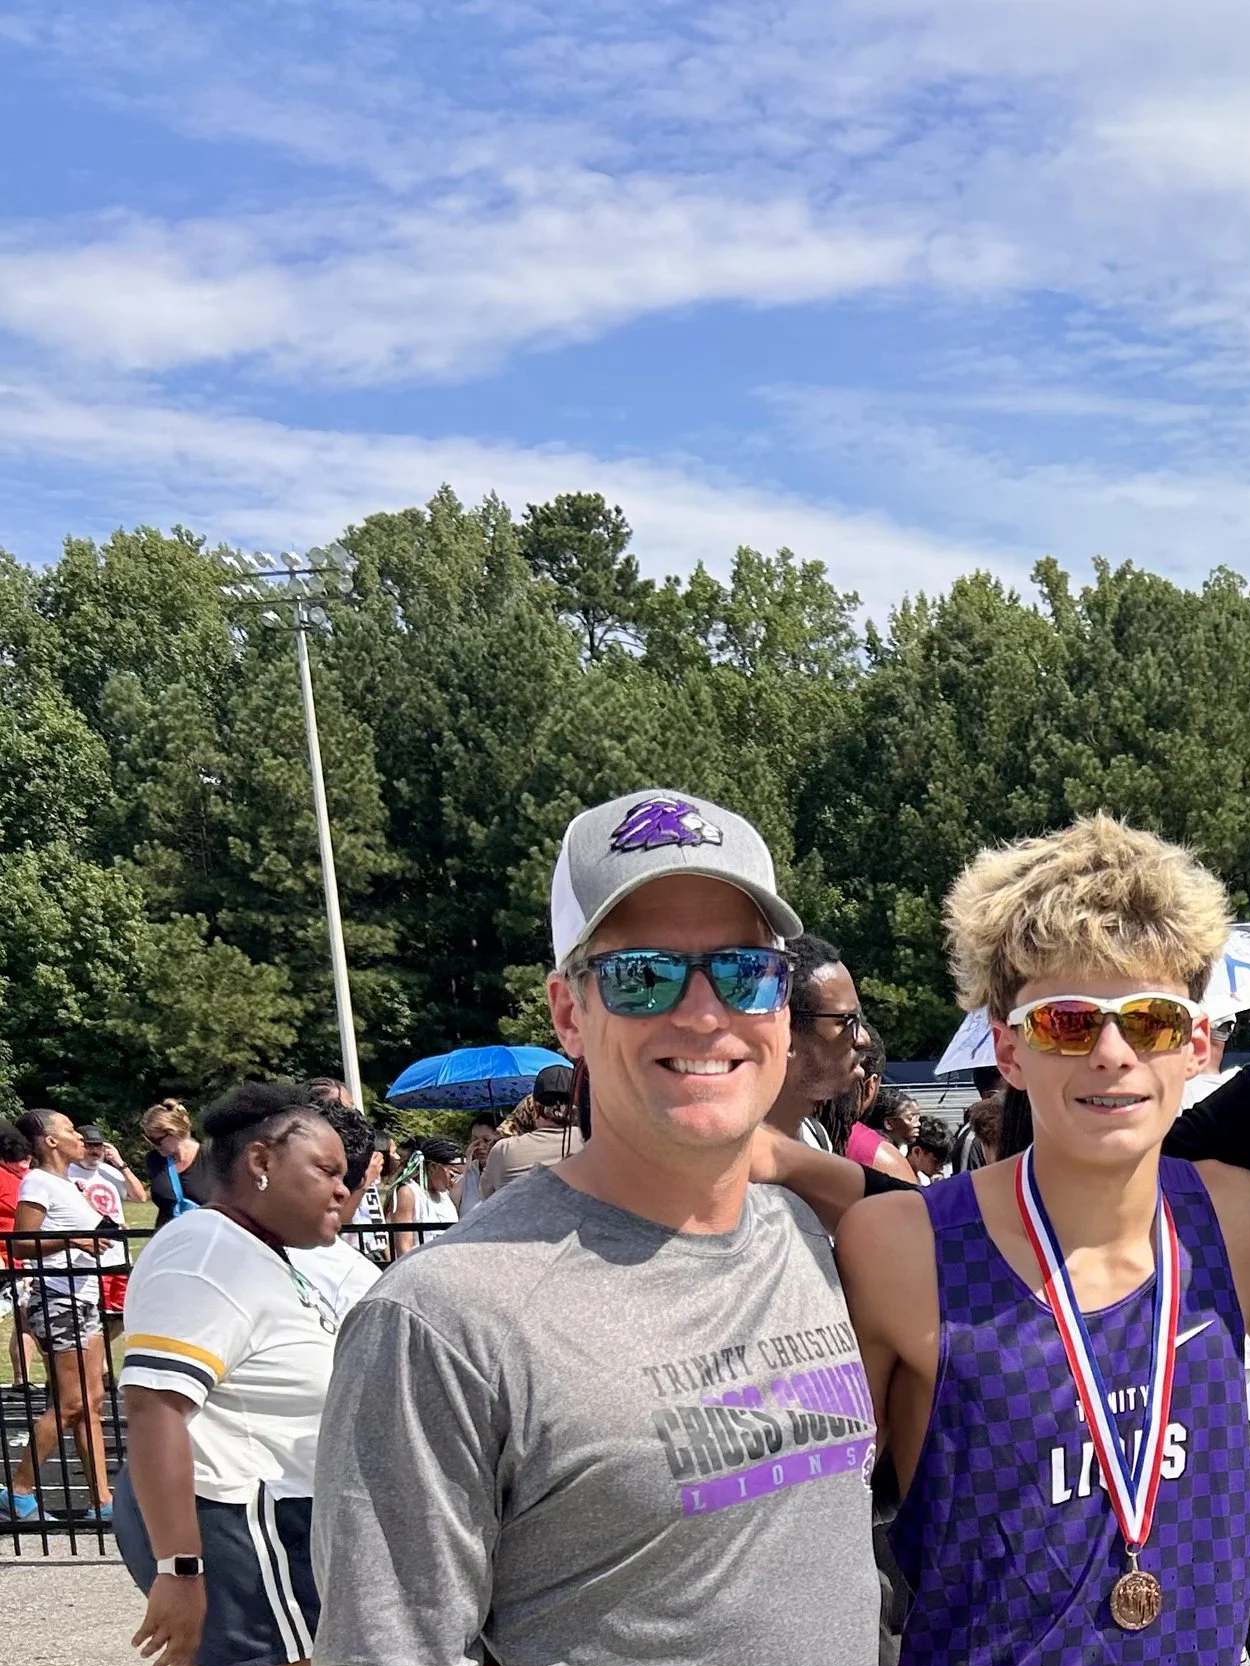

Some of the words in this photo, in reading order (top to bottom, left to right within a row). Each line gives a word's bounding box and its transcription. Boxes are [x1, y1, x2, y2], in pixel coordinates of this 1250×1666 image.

[643, 1344, 753, 1398] TRINITY
[757, 1321, 858, 1370] CHRISTIAN
[653, 1385, 783, 1480] CROSS
[1076, 1385, 1149, 1421] TNITY
[691, 1446, 857, 1511] LIONS
